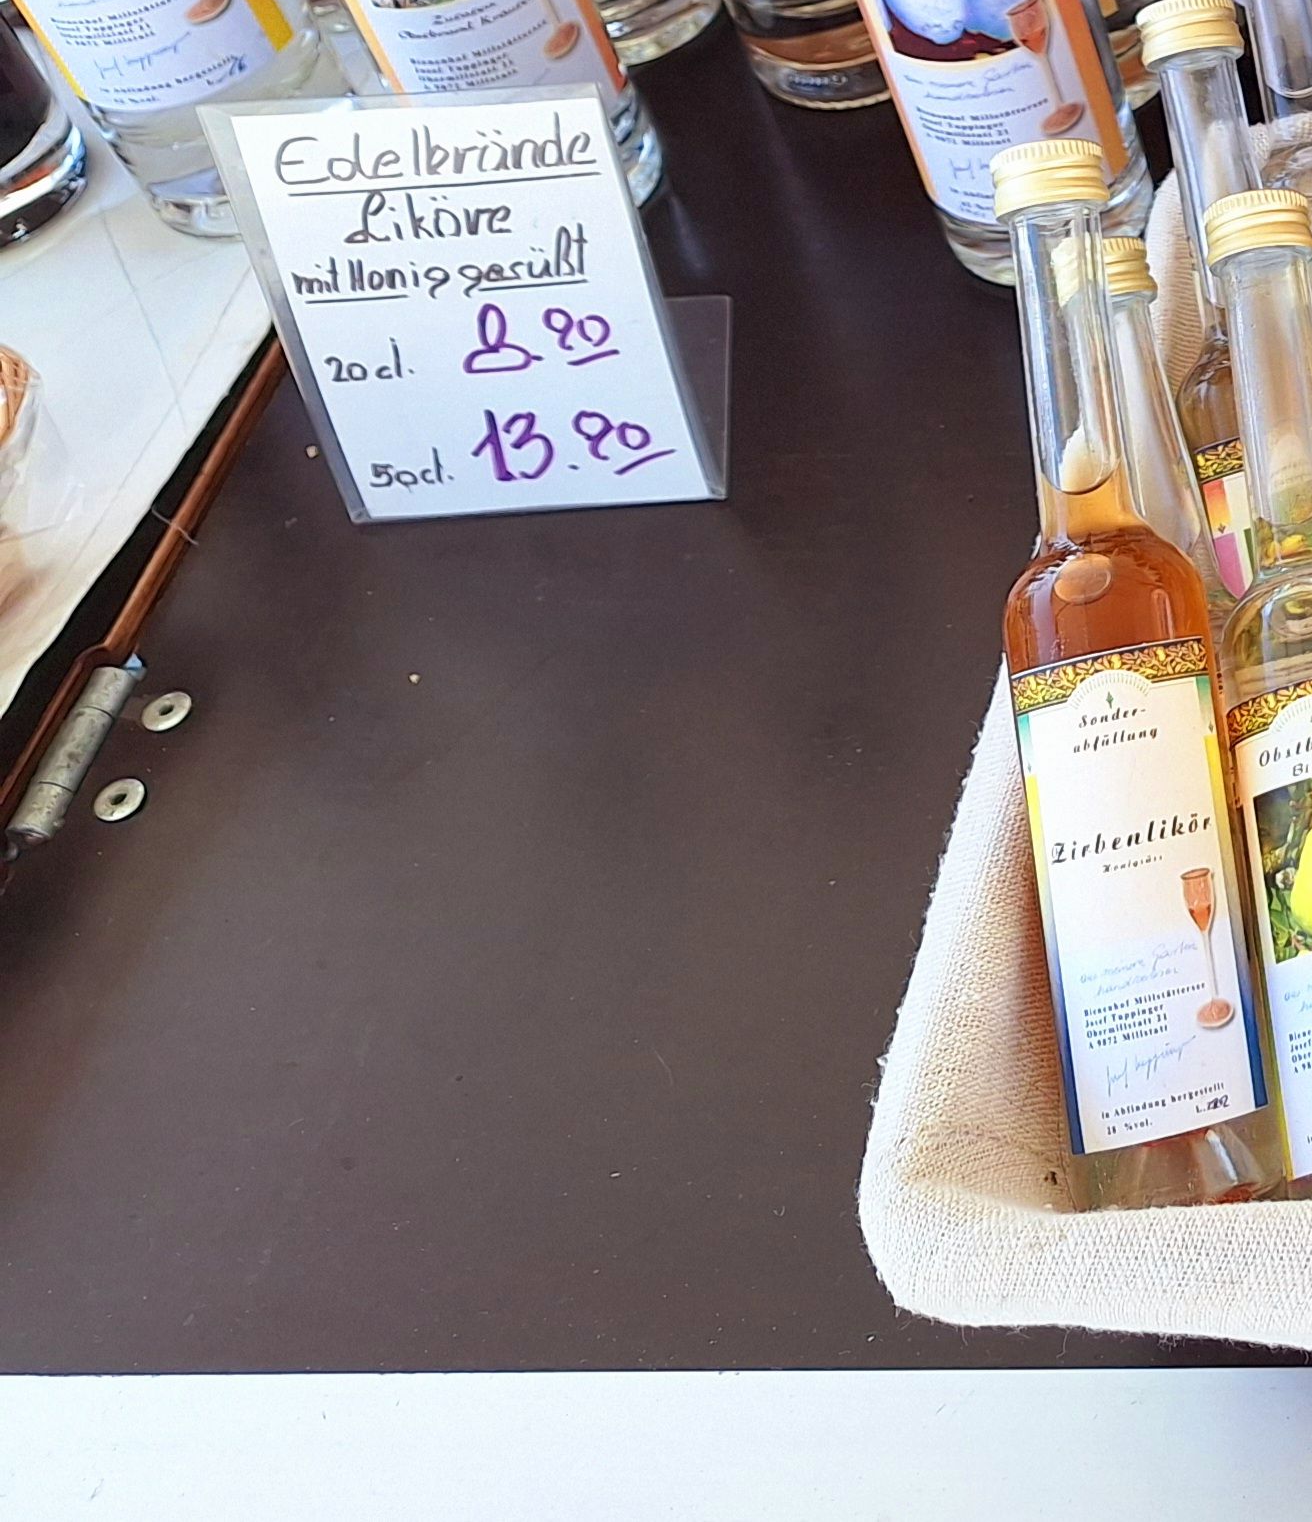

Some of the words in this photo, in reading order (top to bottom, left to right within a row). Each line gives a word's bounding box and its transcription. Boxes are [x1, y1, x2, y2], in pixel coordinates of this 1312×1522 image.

[275, 112, 597, 186] Edelbrände
[292, 256, 339, 296] mit
[1078, 706, 1147, 729] Sonder-
[1072, 725, 1160, 755] abfüllung
[1049, 813, 1212, 866] Zirbenlikör
[1084, 999, 1130, 1017] Bienenhof
[1085, 1018, 1108, 1028] Josef
[1086, 1019, 1152, 1038] Obermillstatt
[1097, 1037, 1118, 1047] 9872
[1123, 1024, 1168, 1042] Millstatt
[1290, 1040, 1312, 1052] Josef
[1114, 1098, 1166, 1117] Abfindung
[1171, 1082, 1225, 1103] hergestellt
